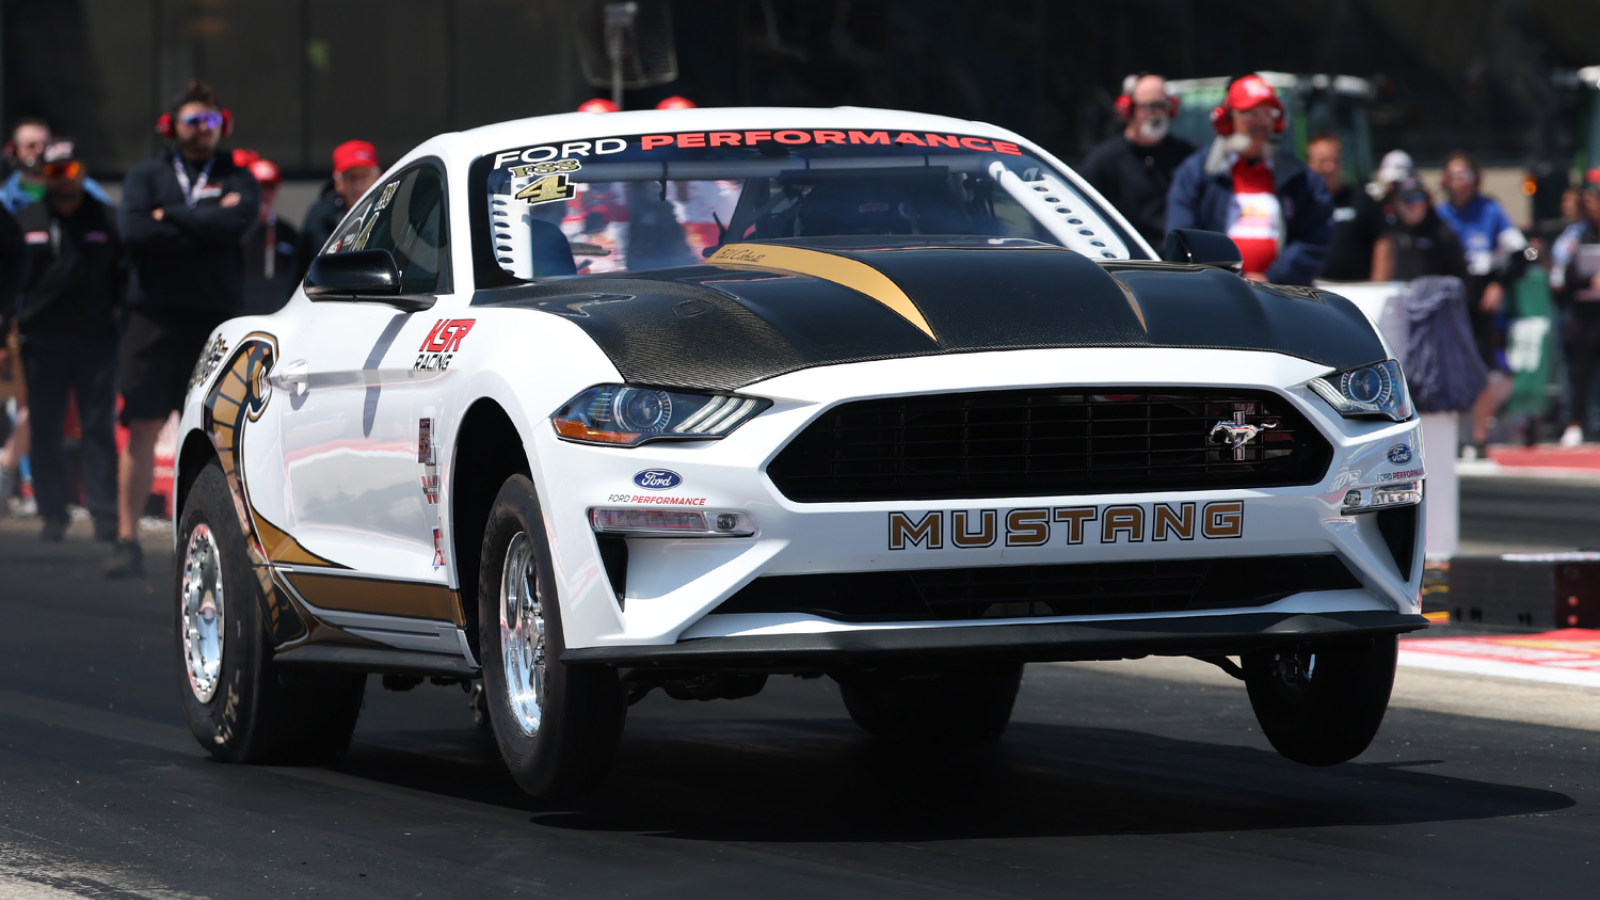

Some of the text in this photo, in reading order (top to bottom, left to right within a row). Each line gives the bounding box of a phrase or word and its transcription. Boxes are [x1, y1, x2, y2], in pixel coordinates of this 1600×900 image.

[493, 130, 1022, 170] FORD PERFORMANCE
[510, 159, 580, 178] FSS
[514, 175, 576, 205] 4
[418, 318, 477, 353] KSR
[413, 354, 453, 372] RACING
[641, 472, 673, 486] Ford
[1377, 473, 1392, 482] FORD
[608, 494, 706, 506] FORD PERFORMANCE
[888, 500, 1245, 551] MUSTANG
